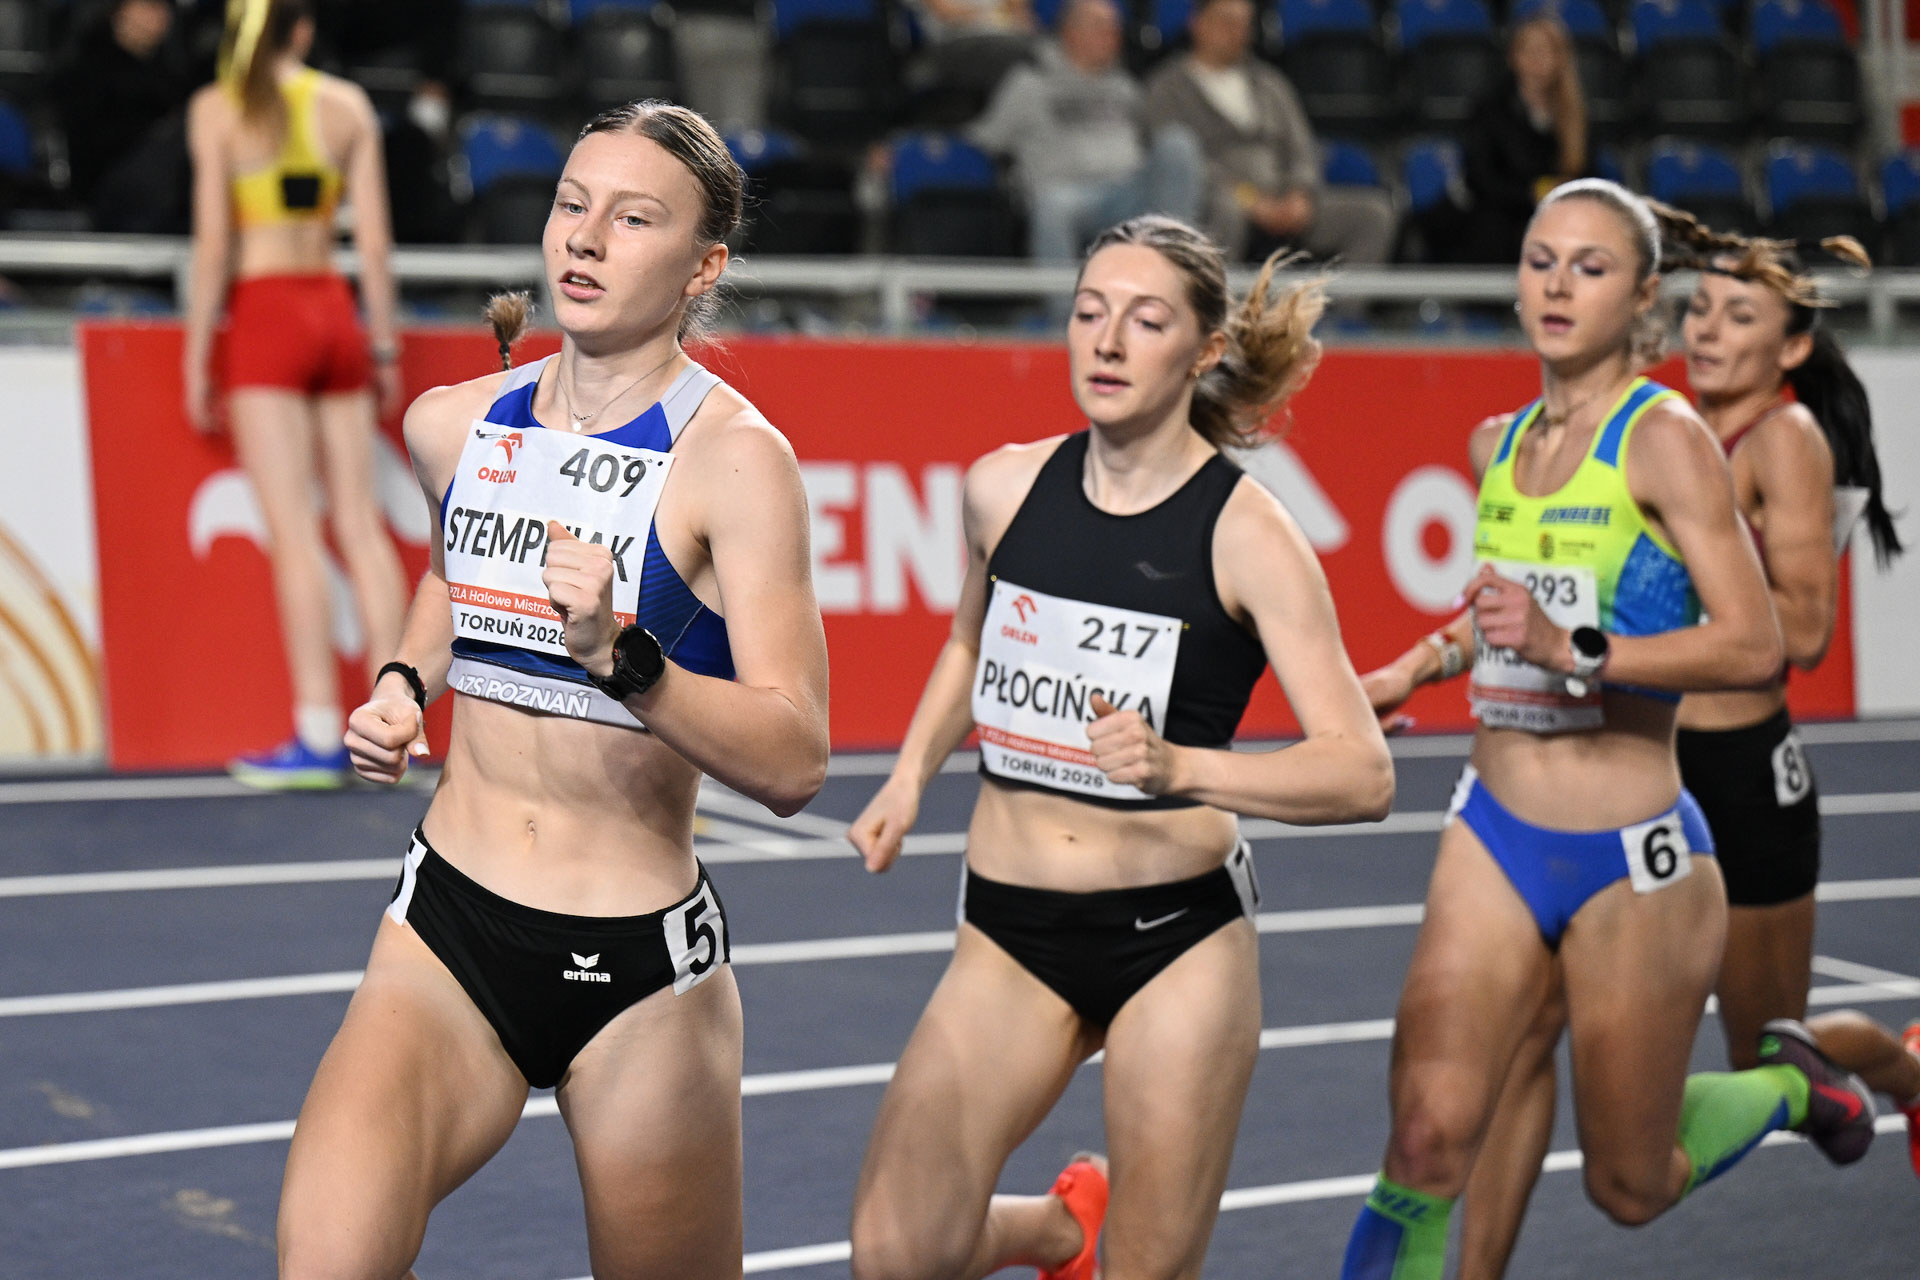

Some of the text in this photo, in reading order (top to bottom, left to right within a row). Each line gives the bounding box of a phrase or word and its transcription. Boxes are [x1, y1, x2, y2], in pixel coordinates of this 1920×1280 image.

[477, 466, 517, 484] ORLEN
[560, 447, 646, 498] 409
[446, 506, 635, 583] STEMPK
[469, 590, 512, 607] Halowe
[460, 612, 523, 638] TORUŃ
[1000, 624, 1038, 646] ORLEN
[1078, 616, 1160, 659] 217
[456, 674, 591, 718] AZS POZNAŃ
[1001, 754, 1057, 778] TORUŃ
[1061, 768, 1104, 788] 2026
[1783, 745, 1802, 794] 8
[1643, 826, 1677, 880] 6
[685, 896, 716, 975] 5
[563, 968, 611, 983] erima
